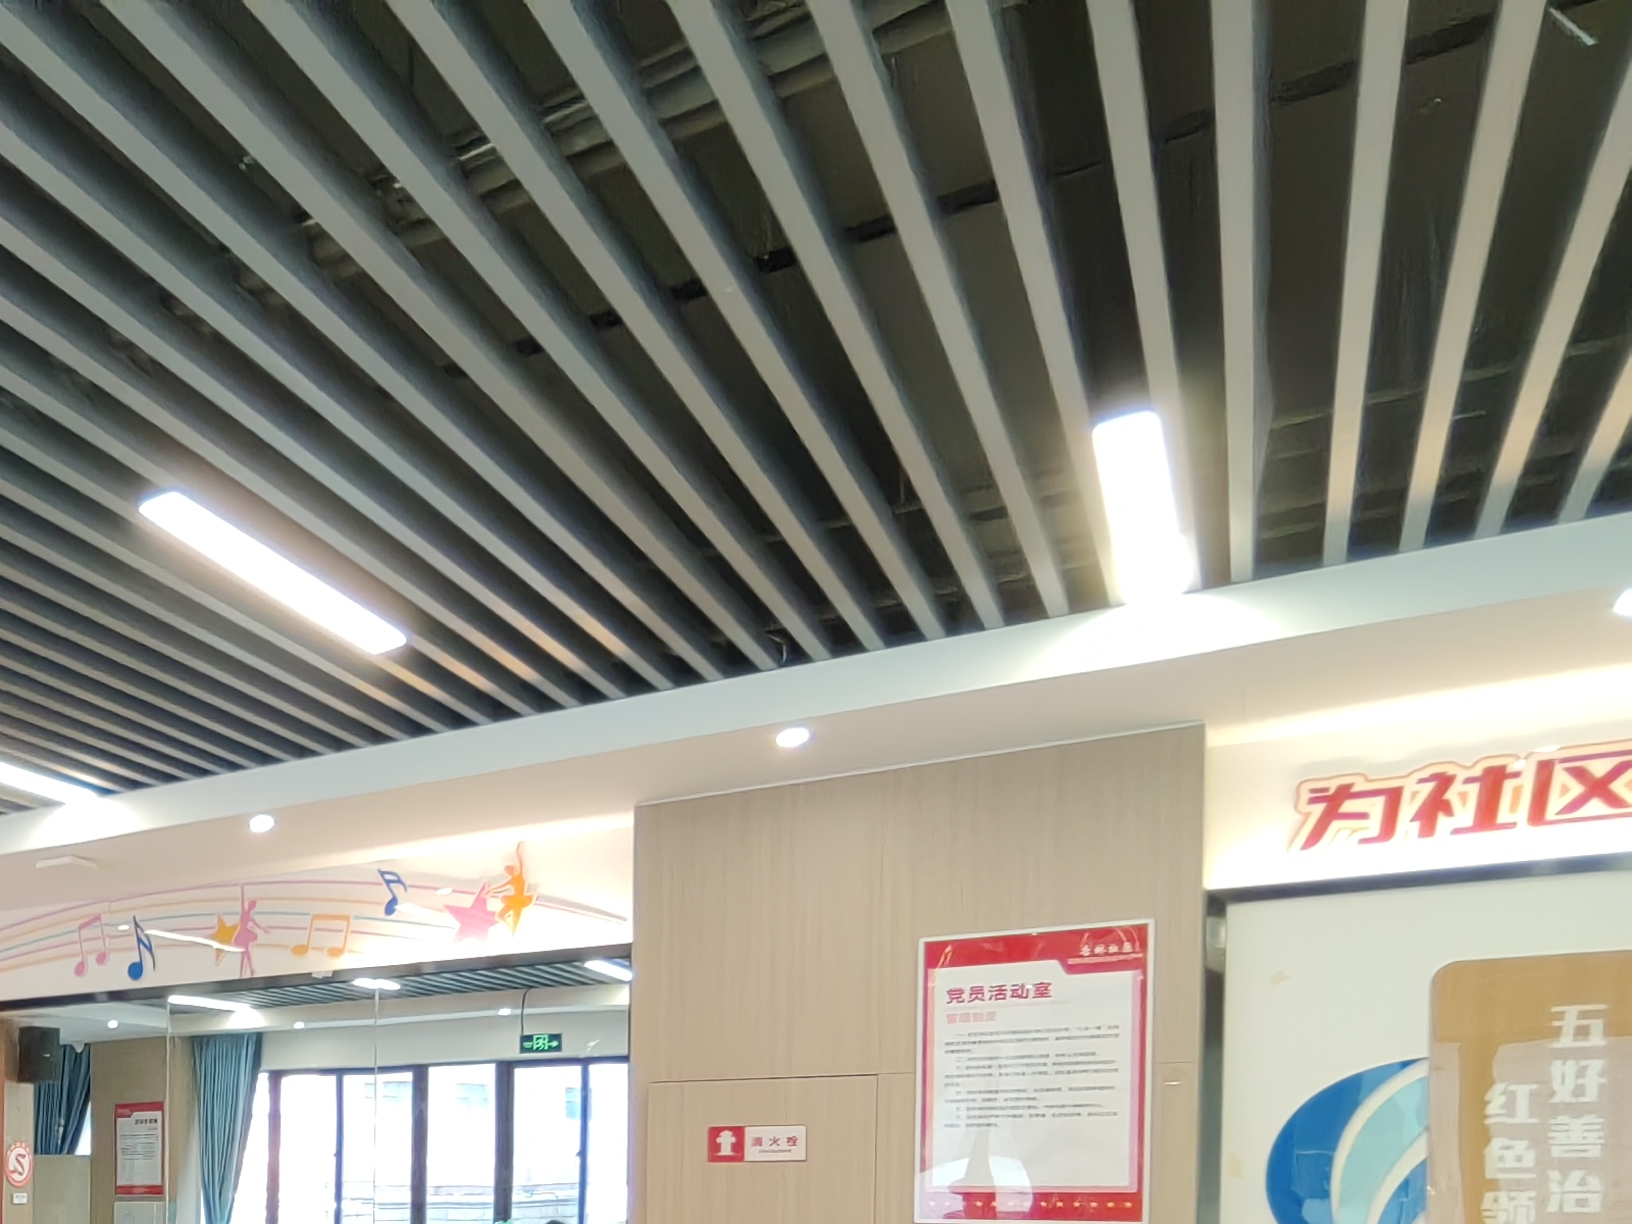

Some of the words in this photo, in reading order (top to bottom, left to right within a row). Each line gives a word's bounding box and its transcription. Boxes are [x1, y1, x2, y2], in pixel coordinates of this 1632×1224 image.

[1300, 748, 1632, 851] 为社区
[946, 981, 1052, 1005] 党员活动室
[1546, 1004, 1609, 1213] 五好善治
